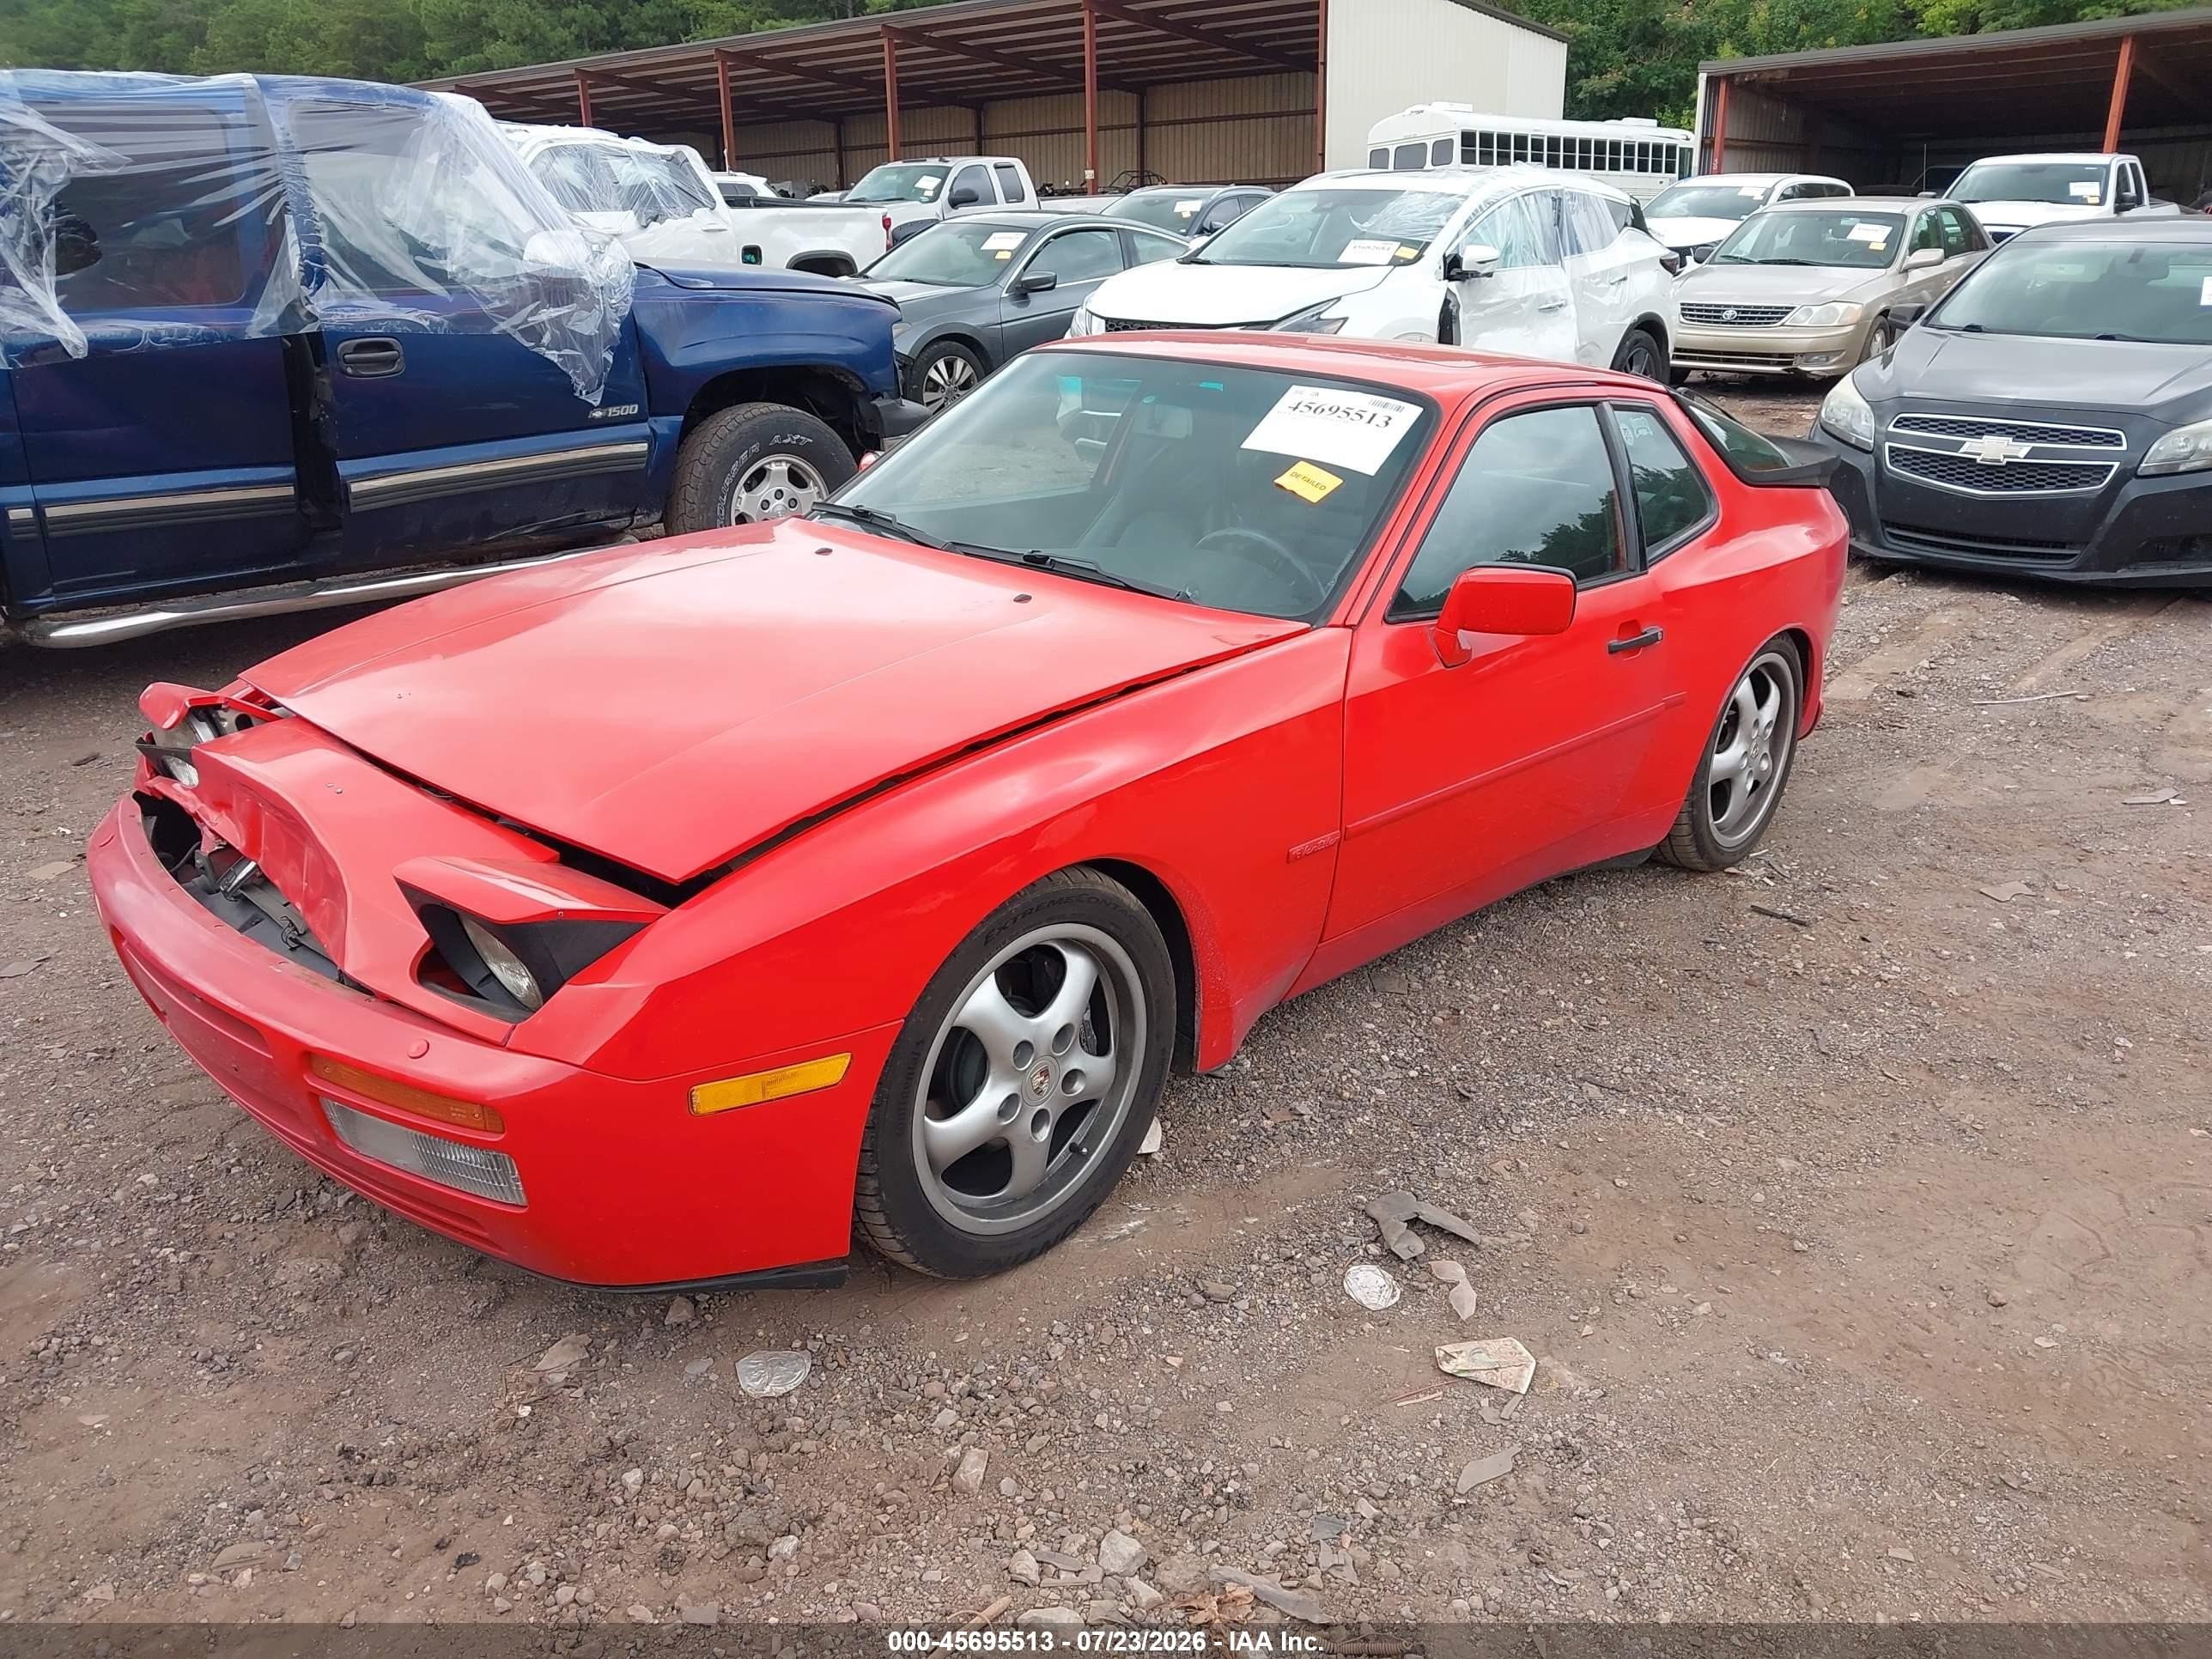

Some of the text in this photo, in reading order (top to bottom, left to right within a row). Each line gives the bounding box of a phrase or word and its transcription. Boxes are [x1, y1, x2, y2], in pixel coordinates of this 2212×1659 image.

[608, 404, 639, 417] 1500
[1288, 400, 1392, 428] 45695513
[769, 434, 813, 446] AXT
[1290, 471, 1327, 490] DETAILED
